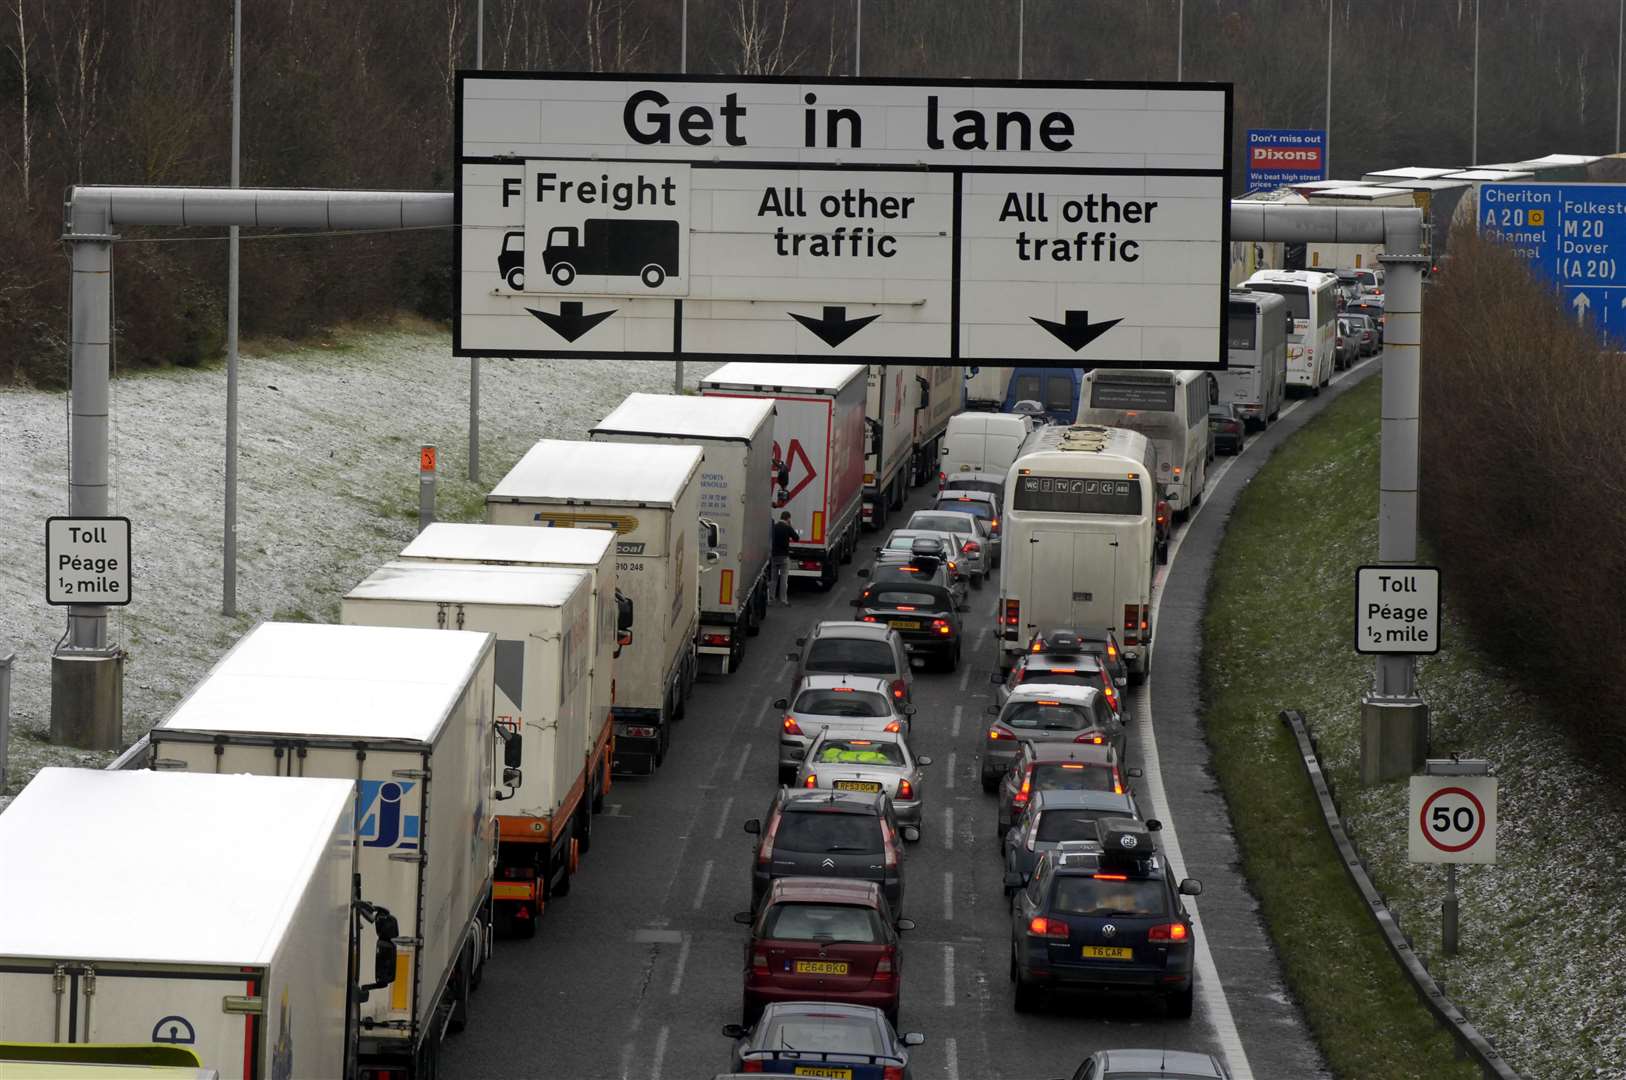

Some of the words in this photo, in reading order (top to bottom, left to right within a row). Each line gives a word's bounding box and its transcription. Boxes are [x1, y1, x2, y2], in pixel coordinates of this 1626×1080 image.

[624, 90, 747, 146] Get
[805, 93, 862, 148] in
[927, 96, 1075, 152] lane
[1250, 134, 1277, 143] Don't
[1280, 135, 1302, 143] miss
[1305, 135, 1321, 143] out
[1254, 148, 1318, 160] Dixons
[1264, 173, 1280, 181] beat
[1282, 174, 1298, 182] high
[537, 173, 676, 210] Freight
[1486, 189, 1551, 203] Cheriton
[758, 187, 807, 216] All
[820, 189, 915, 218] other
[999, 193, 1049, 222] All
[1062, 193, 1158, 223] other
[774, 227, 897, 258] traffic
[1016, 232, 1140, 262] traffic
[1564, 241, 1609, 254] Dover
[69, 527, 107, 543] Toll
[59, 554, 118, 573] Péage
[77, 576, 119, 593] mile
[1378, 576, 1417, 593] Toll
[1368, 603, 1428, 623] Péage
[1386, 626, 1429, 642] mile
[1432, 806, 1475, 832] 50
